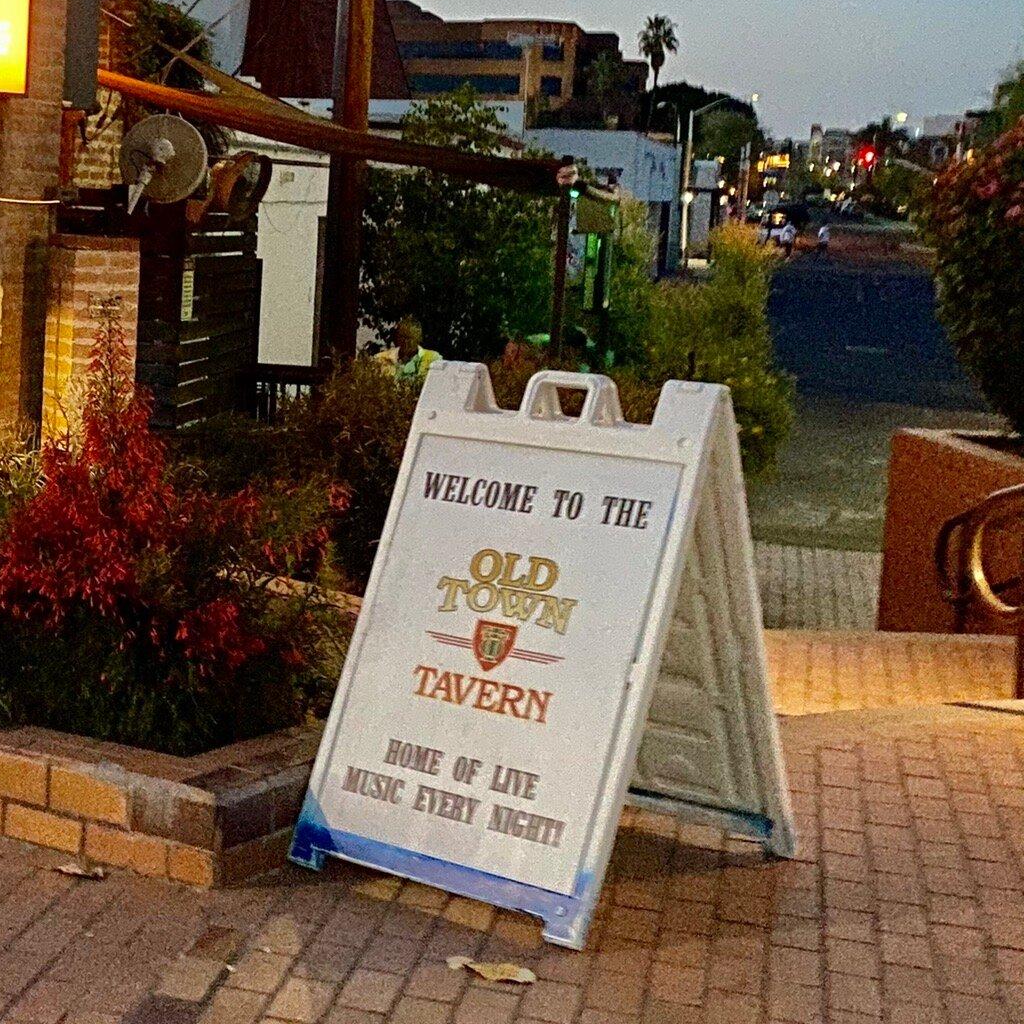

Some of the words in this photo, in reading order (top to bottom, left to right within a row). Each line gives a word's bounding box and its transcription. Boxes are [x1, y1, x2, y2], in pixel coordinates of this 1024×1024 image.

[424, 471, 538, 514] WELCOME
[553, 489, 584, 520] TO
[601, 496, 653, 530] THE
[470, 549, 560, 592] OLD
[436, 576, 579, 635] TOWN
[413, 664, 554, 724] TAVERN
[383, 739, 445, 776] HOME
[452, 756, 483, 785] OF
[489, 765, 541, 800] LIVE
[342, 765, 406, 804] MUSIC
[412, 784, 482, 825] EVERY
[487, 804, 567, 848] NIGHT!
